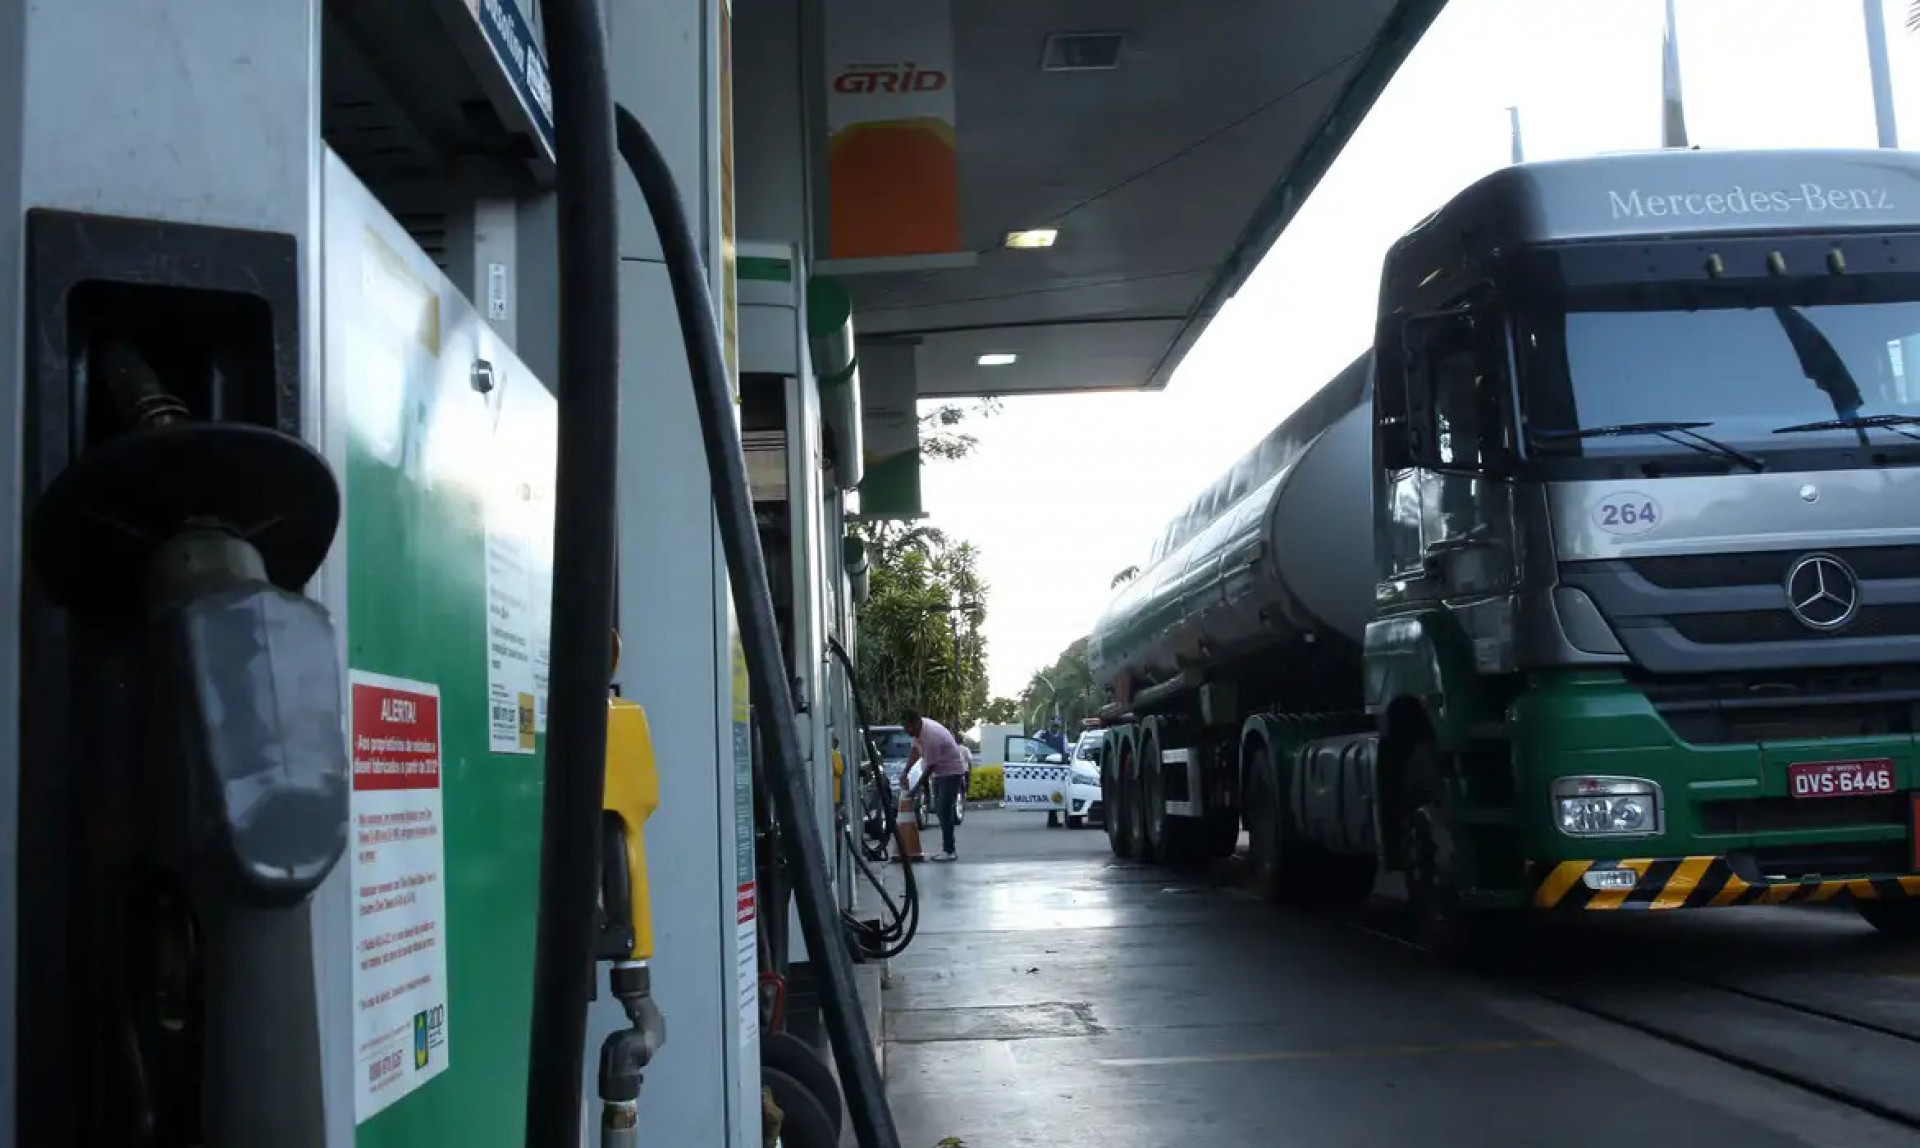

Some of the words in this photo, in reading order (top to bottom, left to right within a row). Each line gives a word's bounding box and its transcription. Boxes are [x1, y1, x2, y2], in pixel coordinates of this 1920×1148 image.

[1608, 183, 1894, 219] Mercedes-Benz
[1602, 501, 1656, 526] 264
[1014, 794, 1050, 803] MILITAR
